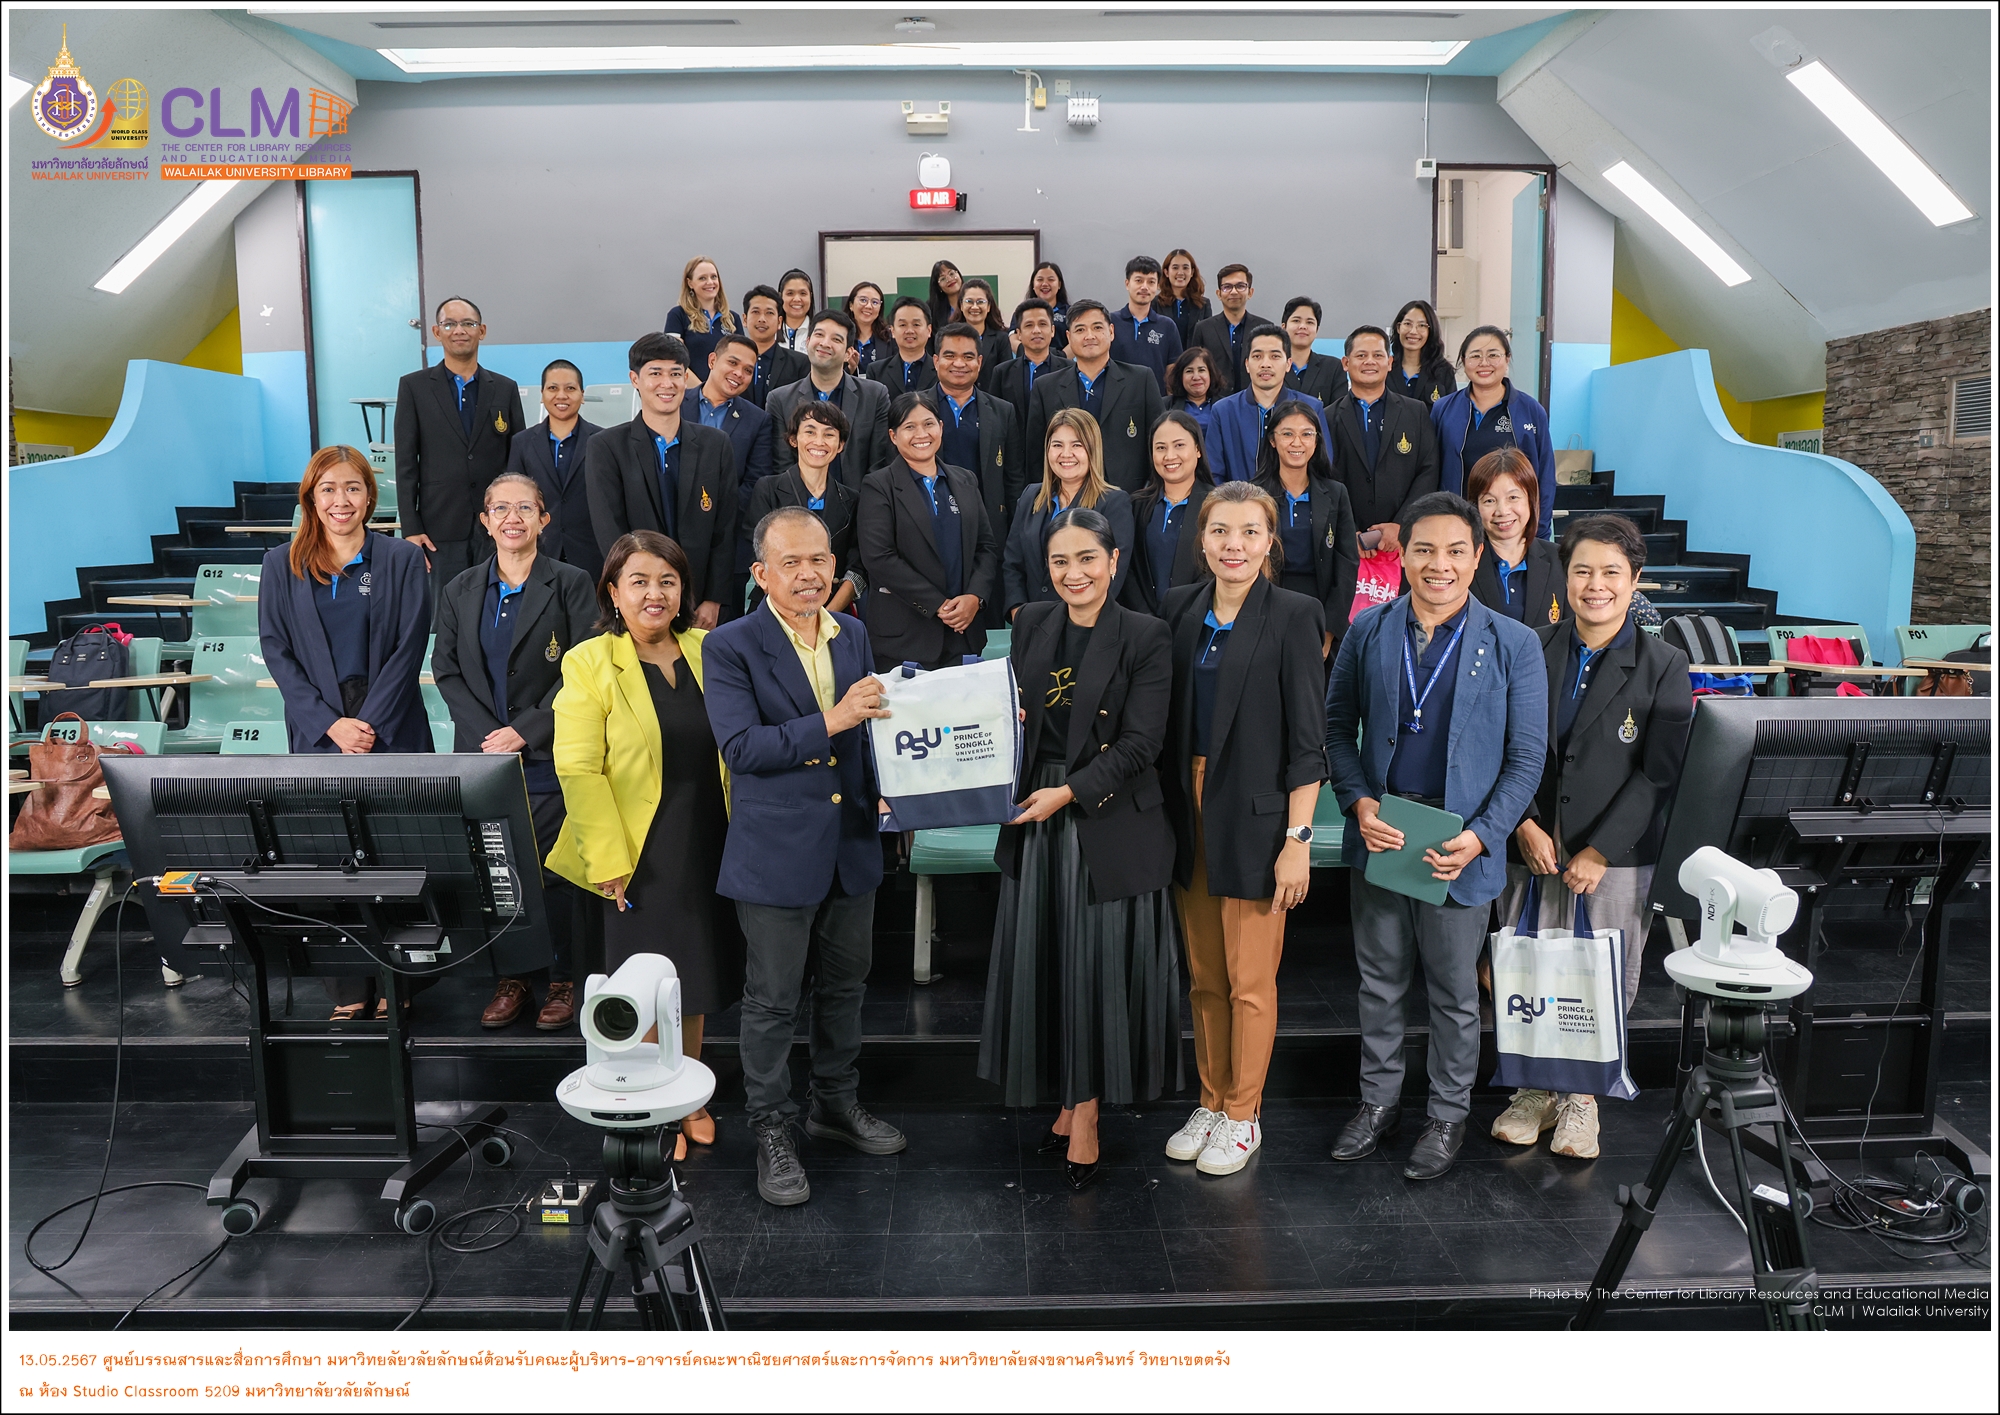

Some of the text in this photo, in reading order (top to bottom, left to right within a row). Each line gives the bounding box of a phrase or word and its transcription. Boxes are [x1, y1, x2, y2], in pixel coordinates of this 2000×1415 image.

[917, 191, 950, 205] ON AIR
[203, 569, 223, 578] G12
[1776, 630, 1795, 639] F02
[1908, 630, 1928, 639] F01
[202, 642, 224, 652] F13
[232, 729, 259, 741] E12
[954, 732, 984, 742] PRINCE
[954, 739, 994, 750] SONGKLA
[956, 747, 995, 756] UNIVERSITY
[1558, 1005, 1586, 1013] PRINCE
[1558, 1014, 1595, 1022] SONGKLA
